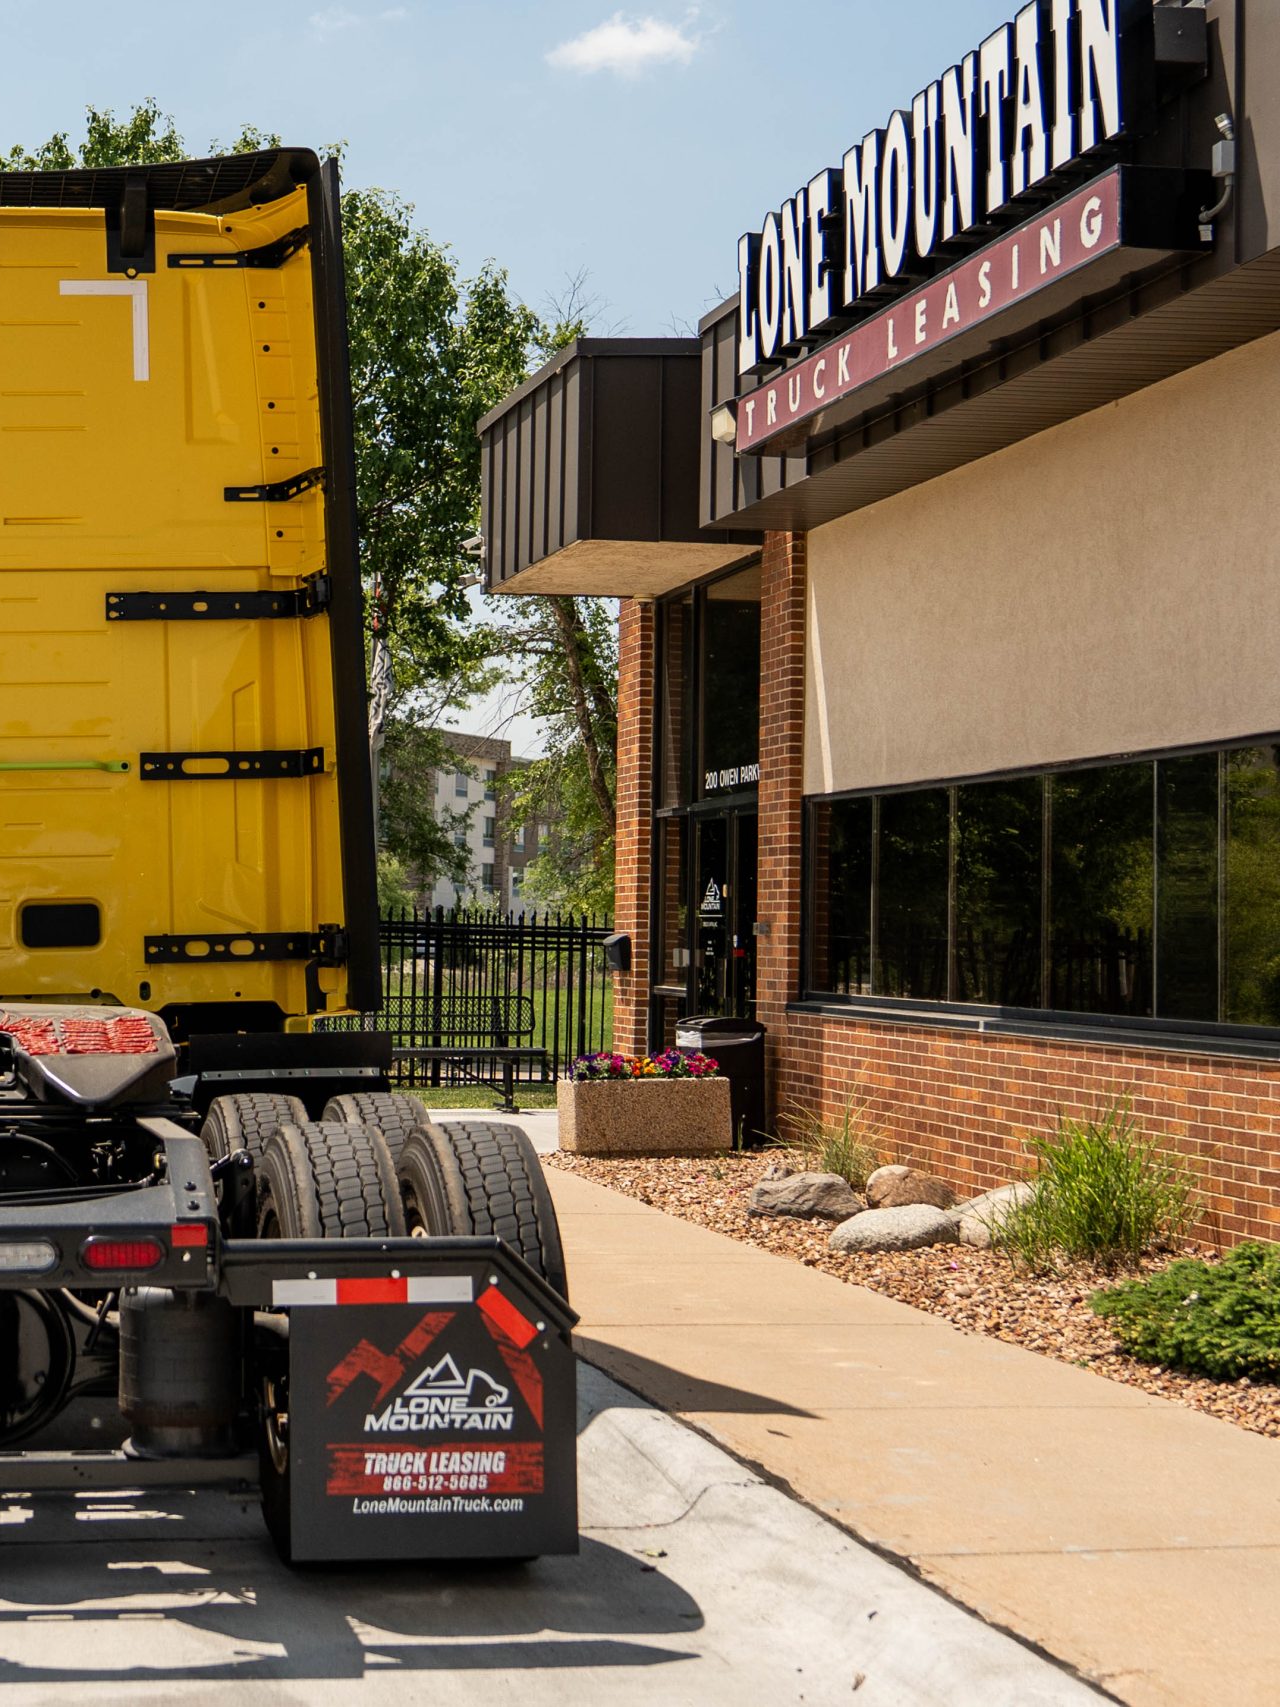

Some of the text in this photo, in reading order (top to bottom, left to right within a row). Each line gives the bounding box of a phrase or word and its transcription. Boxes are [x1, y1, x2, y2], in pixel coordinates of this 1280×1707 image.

[738, 0, 1122, 374] LONE MOUNTAIN
[745, 195, 1103, 437] TRUCK LEASING
[705, 771, 718, 789] 200
[720, 767, 739, 787] OWEN
[363, 1403, 513, 1431] MOUNTAIN
[393, 1396, 469, 1414] LONE
[364, 1451, 506, 1475] TRUCK LEASING
[352, 1496, 523, 1515] LoneMountainTruck.com
